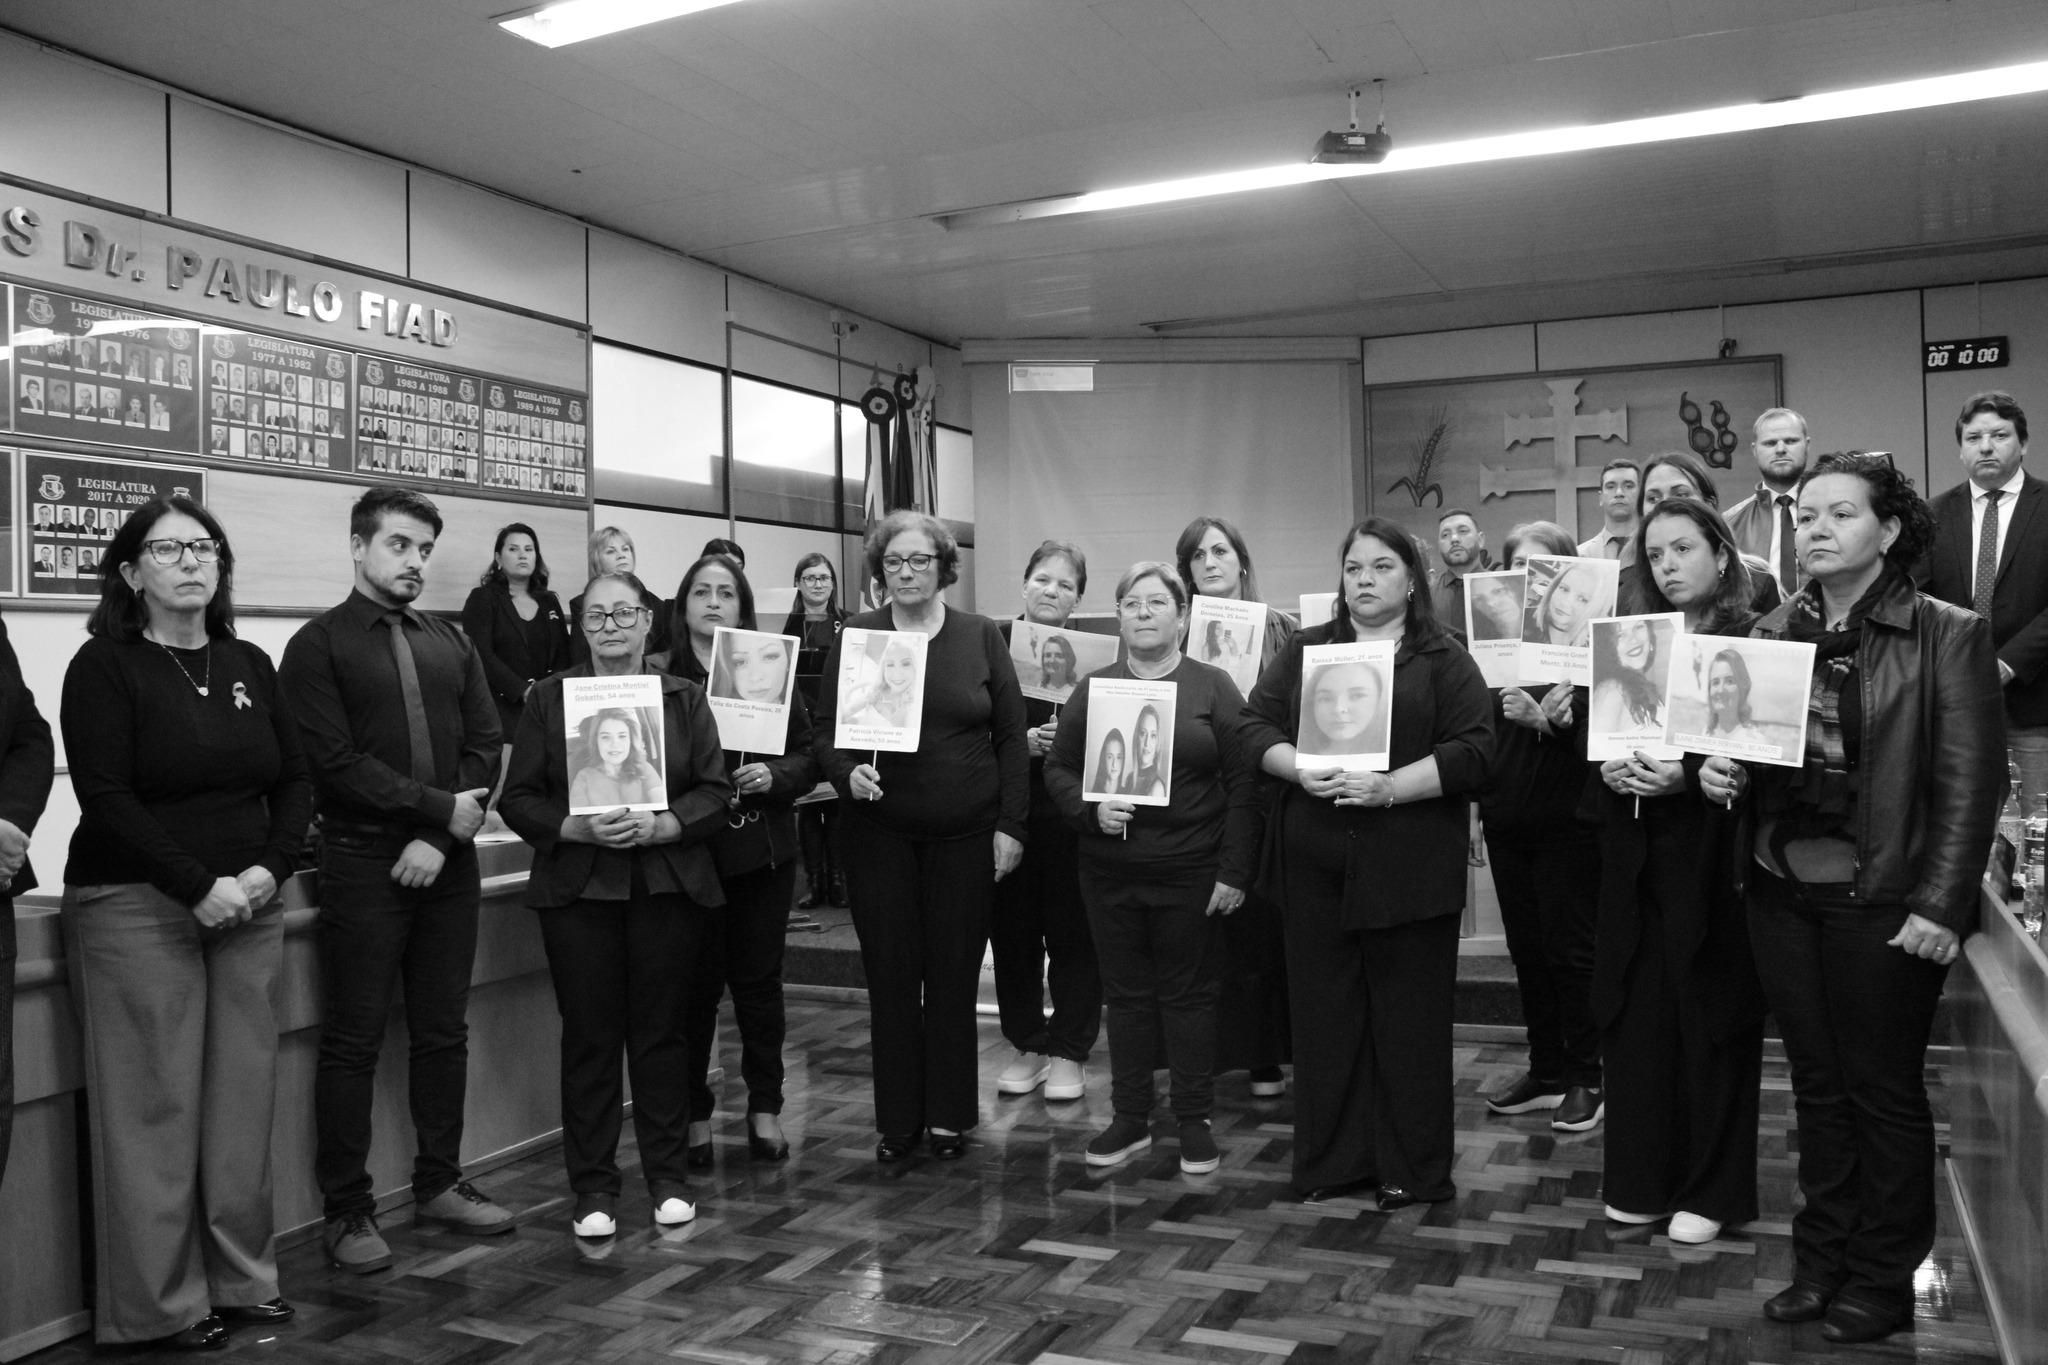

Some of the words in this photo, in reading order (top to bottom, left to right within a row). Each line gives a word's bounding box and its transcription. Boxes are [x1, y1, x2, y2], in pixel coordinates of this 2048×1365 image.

[167, 245, 343, 323] PAULO
[356, 290, 460, 349] FIAD
[248, 338, 315, 359] LEGISLATURA
[252, 351, 276, 364] 1977
[279, 356, 286, 366] A
[289, 358, 312, 371] 1982
[394, 365, 451, 384] LEGISLATURA
[396, 378, 417, 390] 1983
[419, 382, 426, 391] A
[428, 384, 448, 395] 1988
[513, 389, 562, 406] LEGISLATURA
[516, 401, 534, 412] 1989
[542, 406, 559, 416] 1992
[77, 477, 157, 494] LEGISLATURA
[87, 491, 113, 502] 2017
[115, 493, 124, 503] A
[574, 684, 593, 692] Jane
[593, 683, 621, 691] Cristina
[1757, 746, 1779, 755] ANOS
